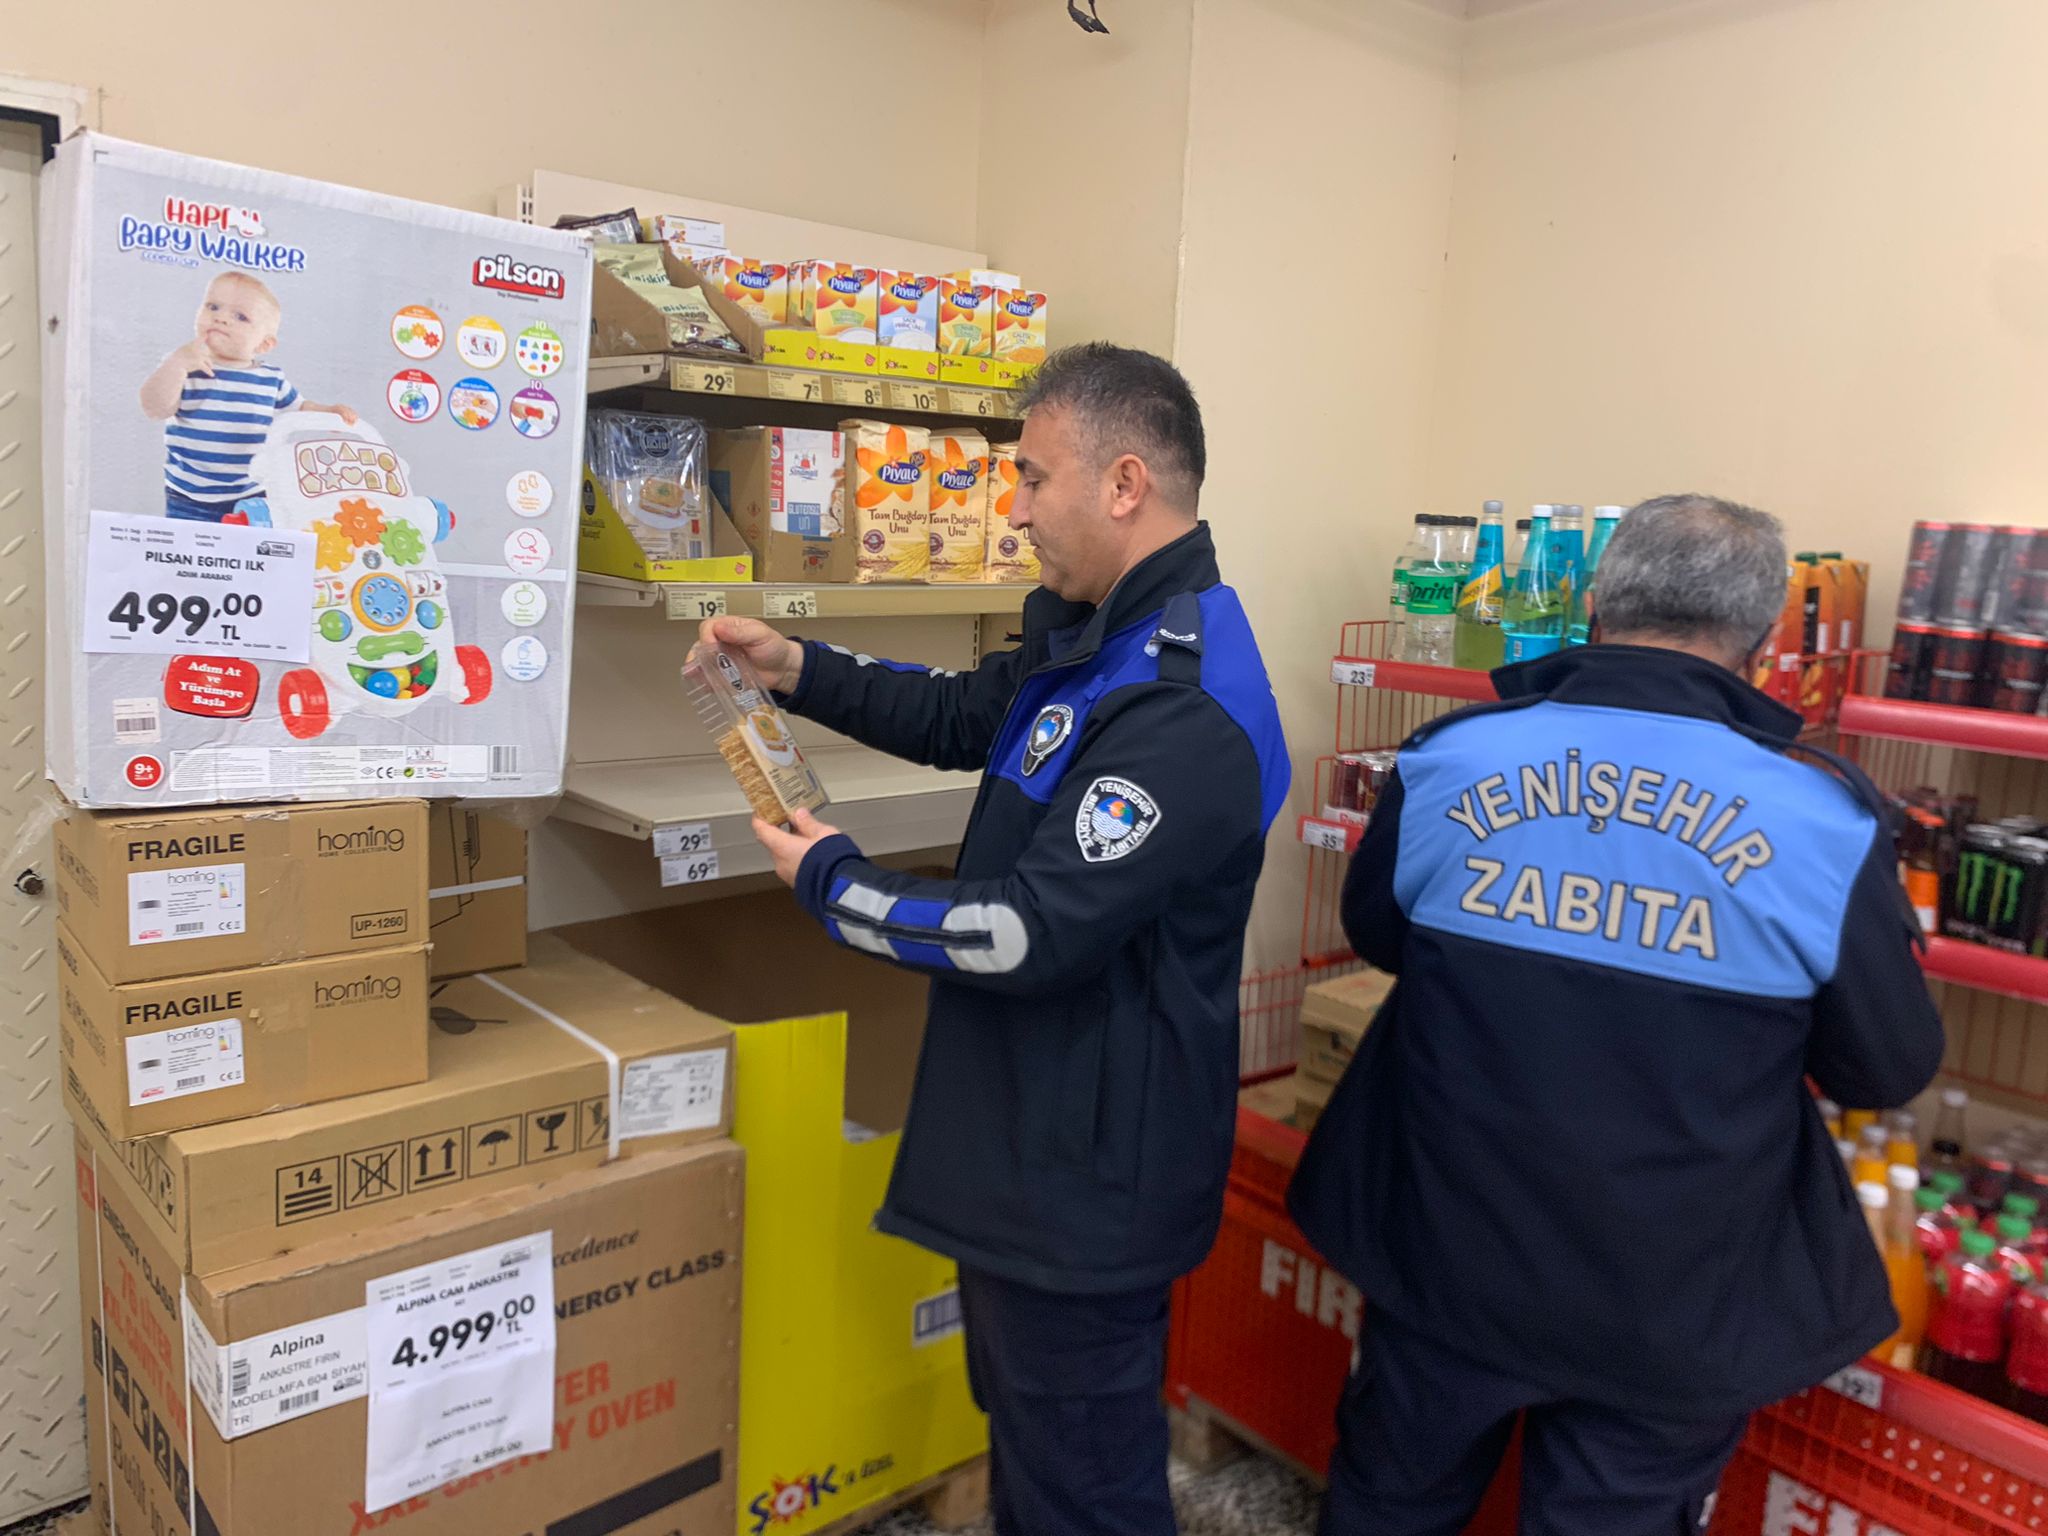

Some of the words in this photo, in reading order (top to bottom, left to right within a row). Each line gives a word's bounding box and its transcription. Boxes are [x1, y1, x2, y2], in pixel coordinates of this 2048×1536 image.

[477, 255, 561, 290] pilsan
[535, 320, 547, 330] 10
[530, 380, 542, 390] 10
[704, 374, 725, 392] 29
[803, 384, 812, 400] 7
[864, 389, 874, 405] 8
[912, 393, 930, 410] 10
[978, 400, 987, 415] 6
[881, 464, 919, 482] Piyale
[867, 508, 891, 521] Tam
[892, 508, 928, 525] Buğday
[929, 512, 949, 524] Tam
[950, 513, 981, 527] Buğday
[889, 522, 909, 534] Unu
[948, 525, 967, 537] Unu
[145, 551, 193, 566] PILSAN
[198, 555, 241, 570] EGITICI
[245, 560, 265, 572] ILK
[176, 570, 198, 579] ADIM
[200, 572, 232, 581] ARABASI
[1407, 580, 1453, 602] Sprite
[698, 601, 717, 618] 19
[786, 601, 807, 617] 43
[221, 624, 241, 641] TL
[188, 661, 223, 675] Adım
[225, 664, 242, 677] At
[1350, 670, 1365, 684] 23
[206, 675, 221, 684] ve
[179, 681, 244, 699] Yürümeye
[192, 694, 226, 708] Başla
[134, 763, 154, 775] 9+
[1098, 782, 1154, 818] YENİŞEHİR
[1079, 793, 1099, 850] BELEDİYE
[1446, 747, 1775, 888] YENİŞEHİR
[128, 833, 246, 862] FRAGILE
[317, 825, 405, 853] homing
[680, 834, 701, 851] 29
[1100, 820, 1149, 858] ZABITASI
[168, 871, 216, 885] homing
[688, 862, 709, 880] 69
[1459, 855, 1719, 961] ZABITA
[354, 915, 404, 932] UP-1260
[314, 974, 401, 1003] homing
[125, 990, 243, 1025] FRAGILE
[167, 1025, 215, 1045] homing
[294, 1167, 322, 1189] 14
[553, 1230, 640, 1269] xcellence
[396, 1293, 436, 1314] ALPINA
[439, 1284, 464, 1300] CAM
[467, 1268, 520, 1292] ANKASTRE
[555, 1276, 640, 1320] NERGY
[646, 1249, 726, 1291] CLASS
[1260, 1238, 1362, 1345] FIR
[505, 1320, 523, 1334] TL
[269, 1333, 324, 1359] Alpina
[258, 1358, 312, 1383] ANKASTRE
[315, 1350, 341, 1366] FIRIN
[307, 1372, 328, 1385] 604
[587, 1377, 678, 1442] OVEN
[233, 1414, 250, 1427] TR
